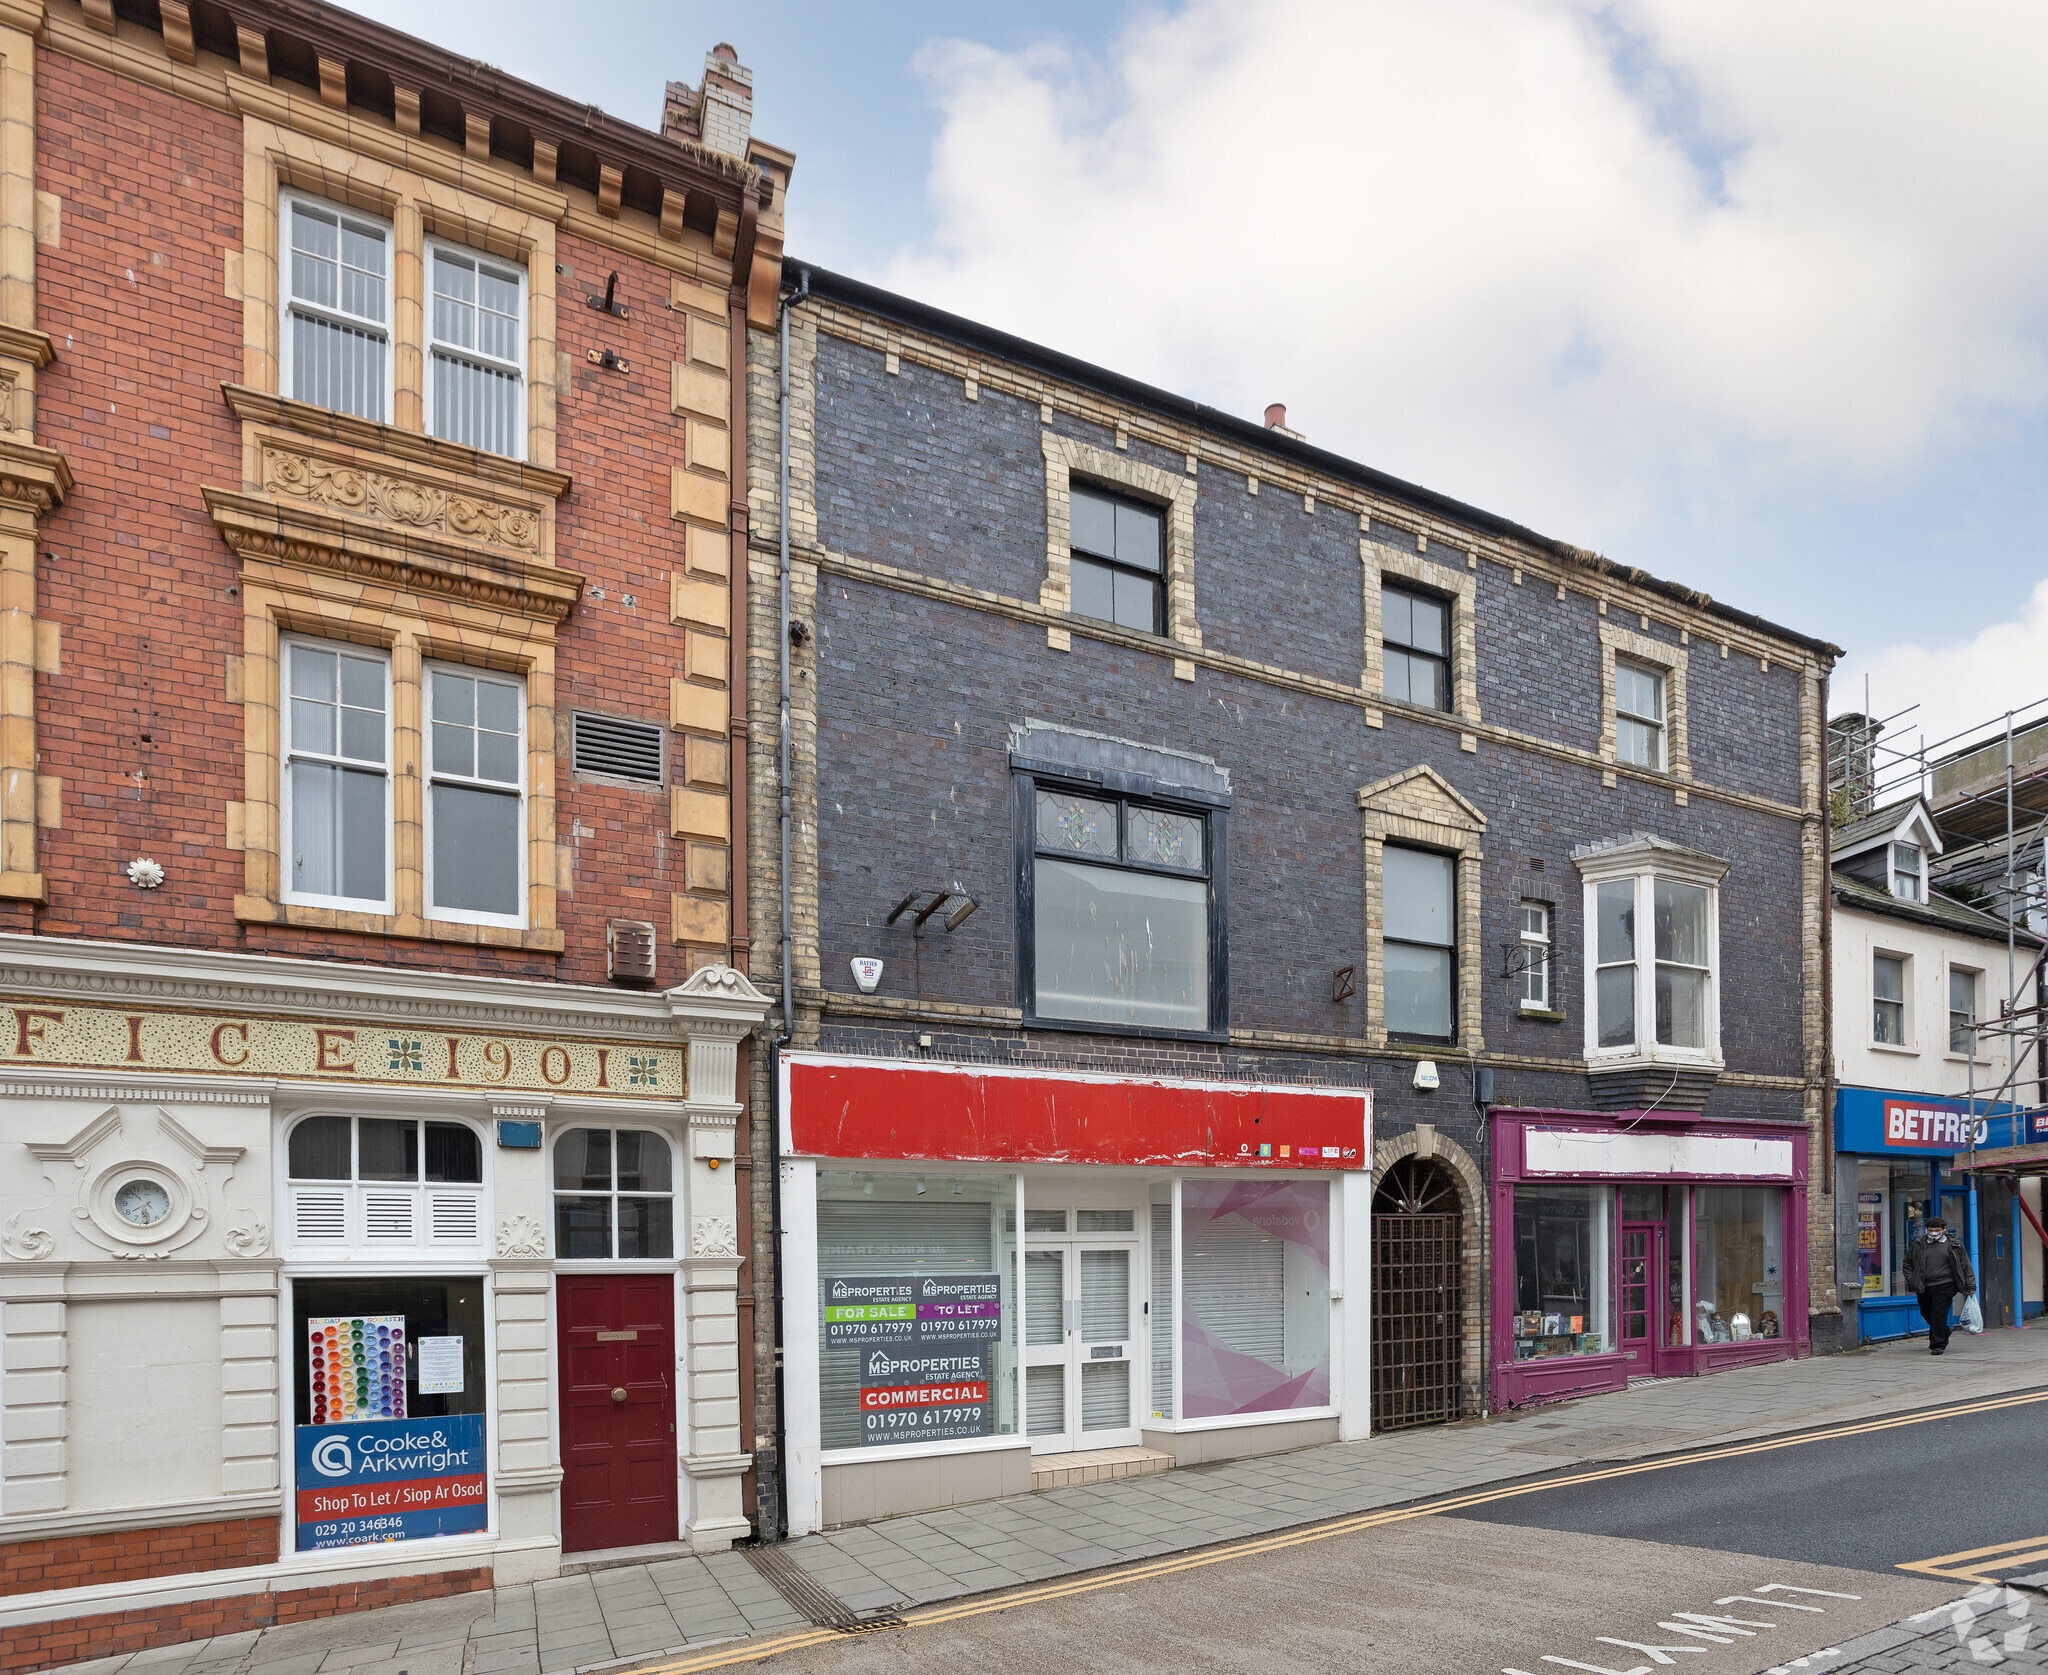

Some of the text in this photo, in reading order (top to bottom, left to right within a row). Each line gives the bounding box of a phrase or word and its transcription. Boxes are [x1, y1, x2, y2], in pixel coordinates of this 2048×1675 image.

[445, 1037, 611, 1088] 1901
[836, 1307, 906, 1319] FOR SALE
[938, 1305, 980, 1315] TO LET
[831, 1323, 913, 1335] 01970 617979
[921, 1320, 998, 1331] 01970 617979
[831, 1335, 912, 1344] WWW.MSPROPERTIES.CO.UK
[925, 1370, 980, 1380] ESTATE AGENCY
[865, 1386, 983, 1406] COMMERCIAL
[866, 1407, 981, 1429] 01970 617979
[357, 1430, 447, 1454] Cooke&
[867, 1425, 981, 1442] WWW.MSPROPERTIES.CO.UK
[359, 1448, 469, 1474] Arkwright
[314, 1481, 483, 1512] Shop To Let / Siop Ar Osod
[315, 1516, 403, 1537] 029 20 346346
[315, 1531, 405, 1549] www.coark.com
